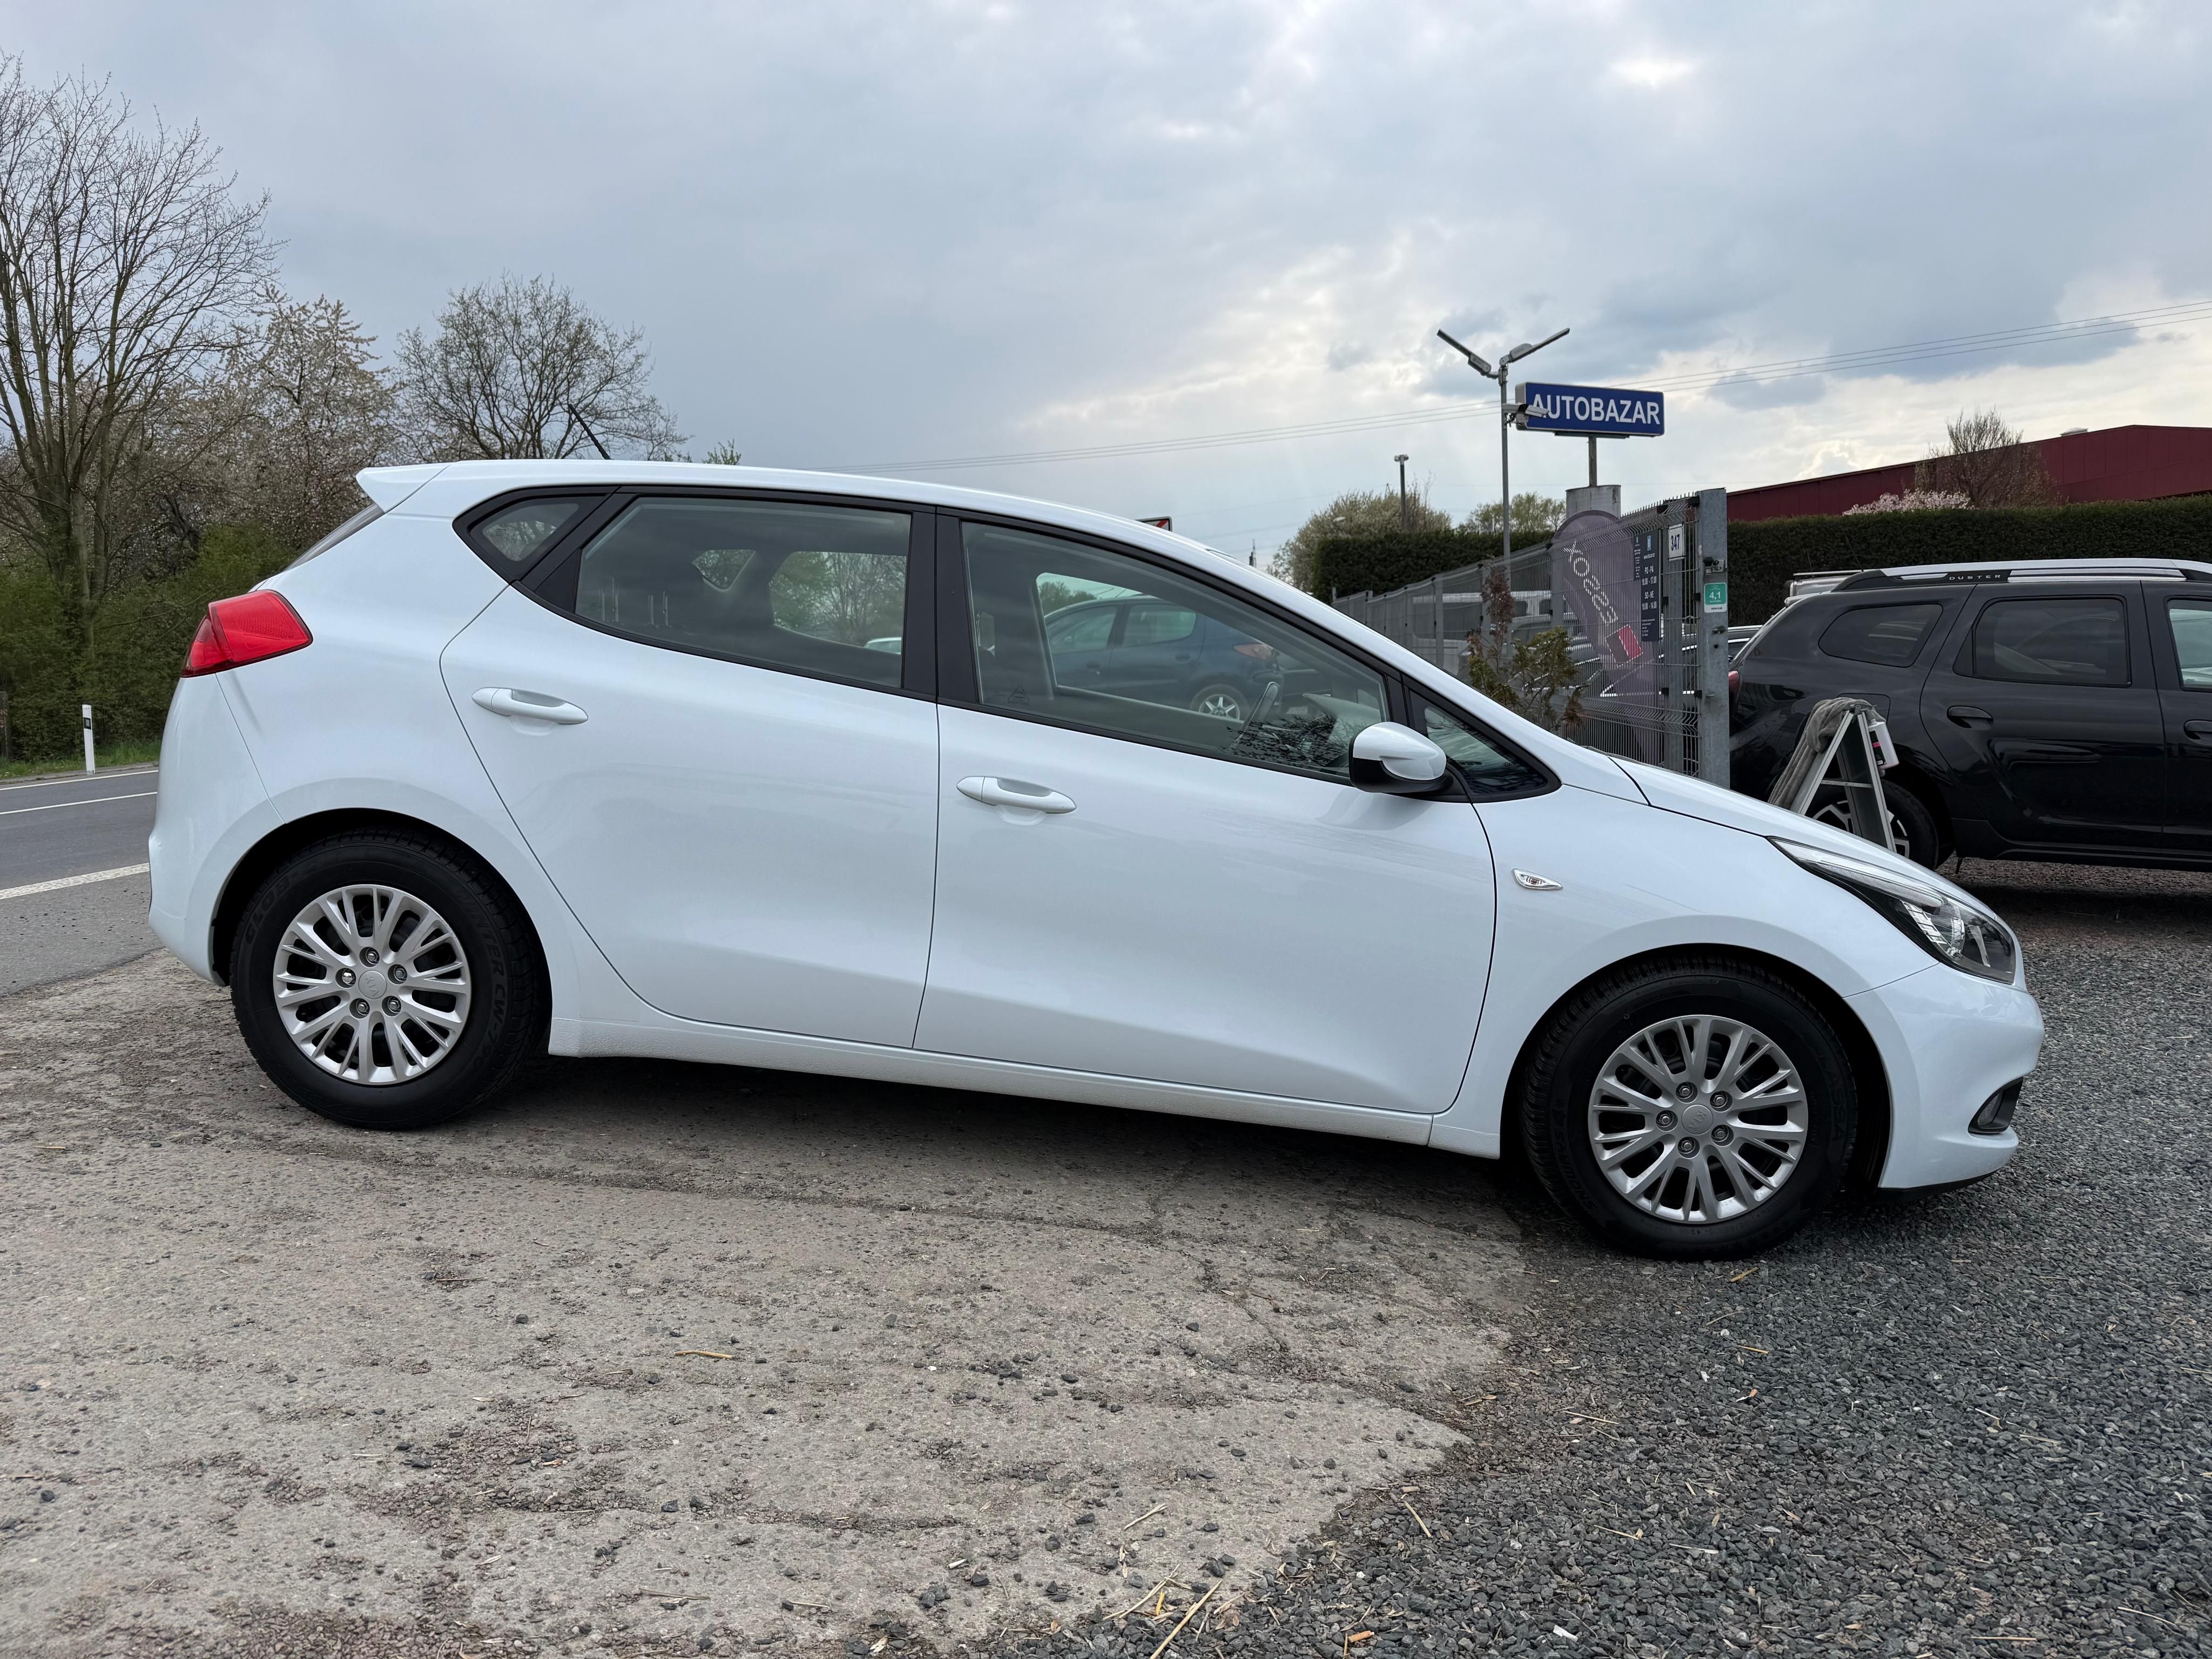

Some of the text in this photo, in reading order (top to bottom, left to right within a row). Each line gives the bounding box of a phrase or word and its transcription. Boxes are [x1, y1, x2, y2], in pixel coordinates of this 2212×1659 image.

[1532, 393, 1660, 425] AUTOBAZAR
[1671, 534, 1680, 551] 347
[1709, 591, 1721, 600] 4,1
[455, 888, 508, 1072] WINTER CW-790
